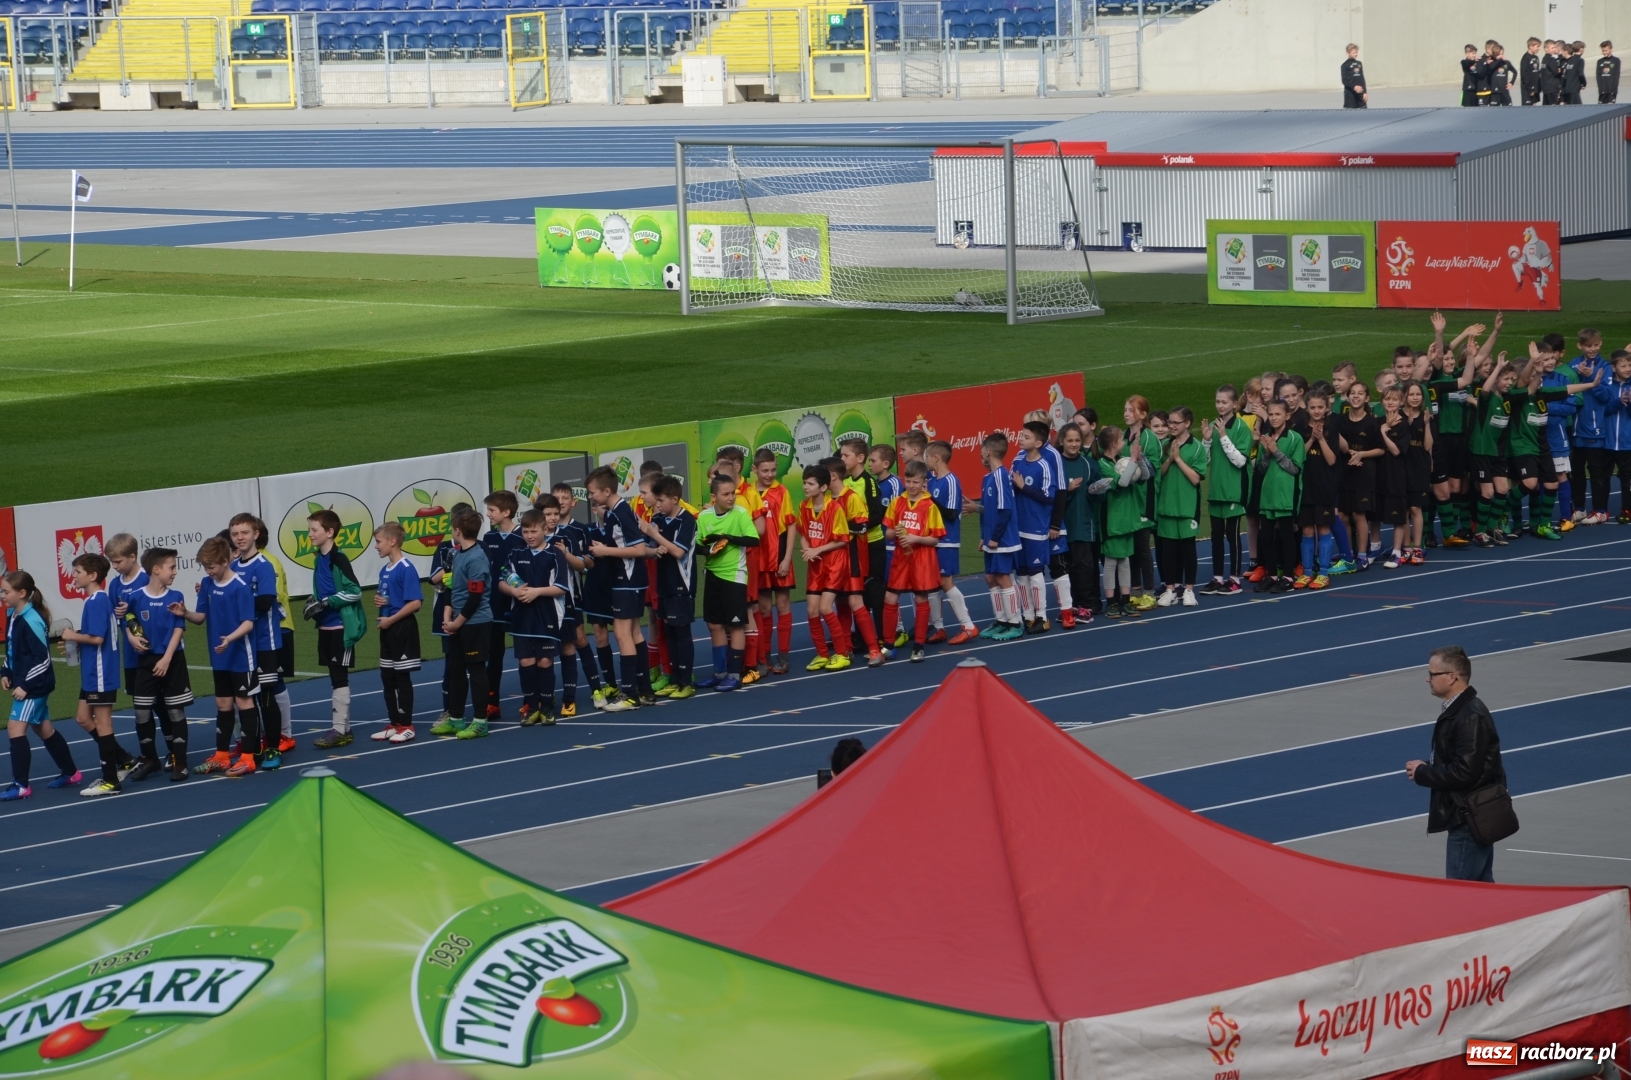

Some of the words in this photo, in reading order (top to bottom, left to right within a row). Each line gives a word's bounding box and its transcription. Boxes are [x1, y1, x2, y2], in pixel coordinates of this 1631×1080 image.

[830, 15, 841, 25] 66
[250, 24, 261, 34] 64
[1169, 155, 1195, 165] polanik
[1348, 156, 1374, 165] polanik
[550, 226, 570, 235] TYMBARK
[577, 229, 599, 238] TYMBARK
[635, 231, 658, 240] TYMBARK
[1258, 257, 1284, 266] TYMBARK
[1333, 257, 1360, 267] TYMBARK
[1389, 279, 1412, 290] PZPN
[803, 443, 822, 454] TYMBARK
[903, 511, 918, 520] ZSG
[402, 516, 452, 536] MIRE
[809, 520, 823, 531] ZSG
[299, 528, 358, 549] MEX
[427, 933, 473, 968] 1936
[89, 945, 152, 977] 1936
[455, 928, 606, 1049] TYMBARK
[0, 967, 245, 1042] YMBARK
[1294, 995, 1377, 1056] Łączy
[1383, 984, 1432, 1030] nas
[1437, 955, 1512, 1036] piłka
